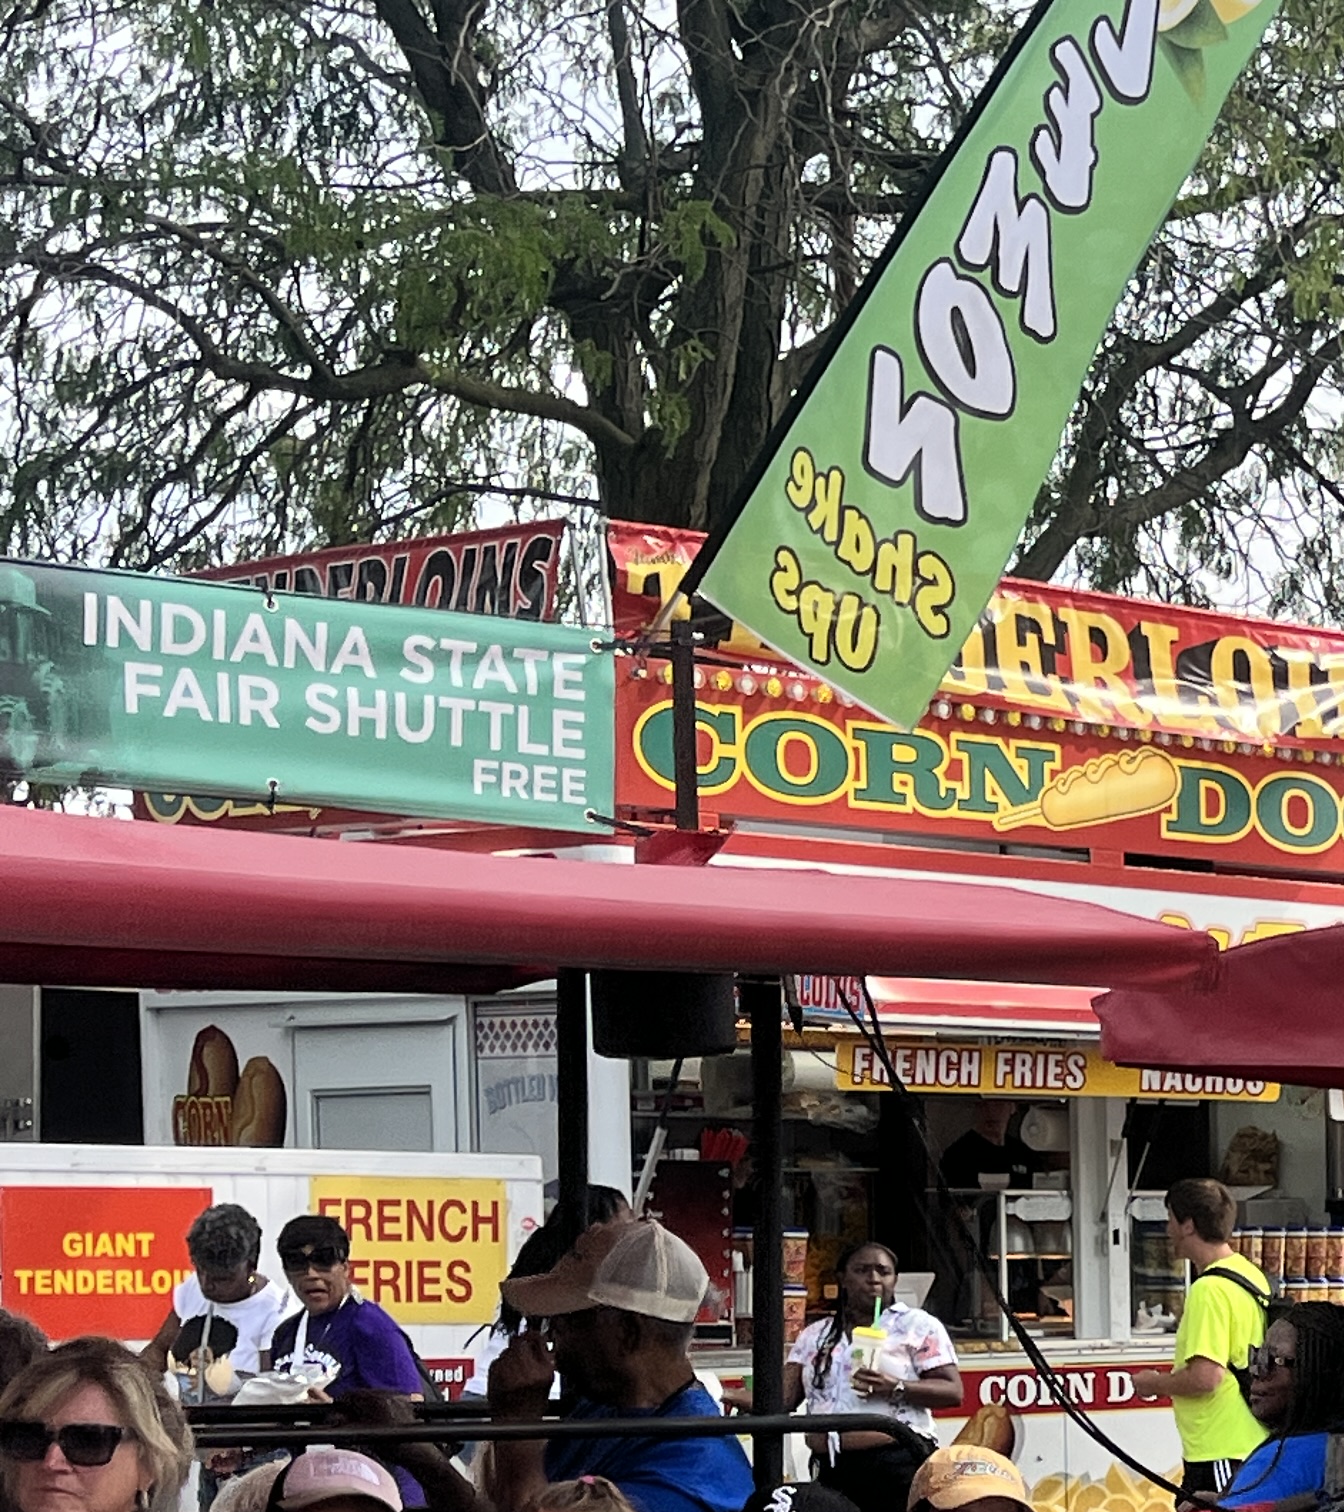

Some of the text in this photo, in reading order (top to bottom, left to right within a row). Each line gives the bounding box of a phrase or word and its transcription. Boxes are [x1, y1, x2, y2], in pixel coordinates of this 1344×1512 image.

[82, 590, 588, 702] INDIANA STATE
[123, 660, 588, 761] FAIR SHUTTLE
[472, 758, 588, 806] FREE
[630, 698, 1060, 822] CORN
[852, 1045, 982, 1087] FRENCH
[994, 1053, 1087, 1090] FRIES
[318, 1199, 499, 1243] FRENCH
[62, 1232, 155, 1257] GIANT
[14, 1269, 194, 1295] TENDERLOI
[979, 1371, 1097, 1408] CORN
